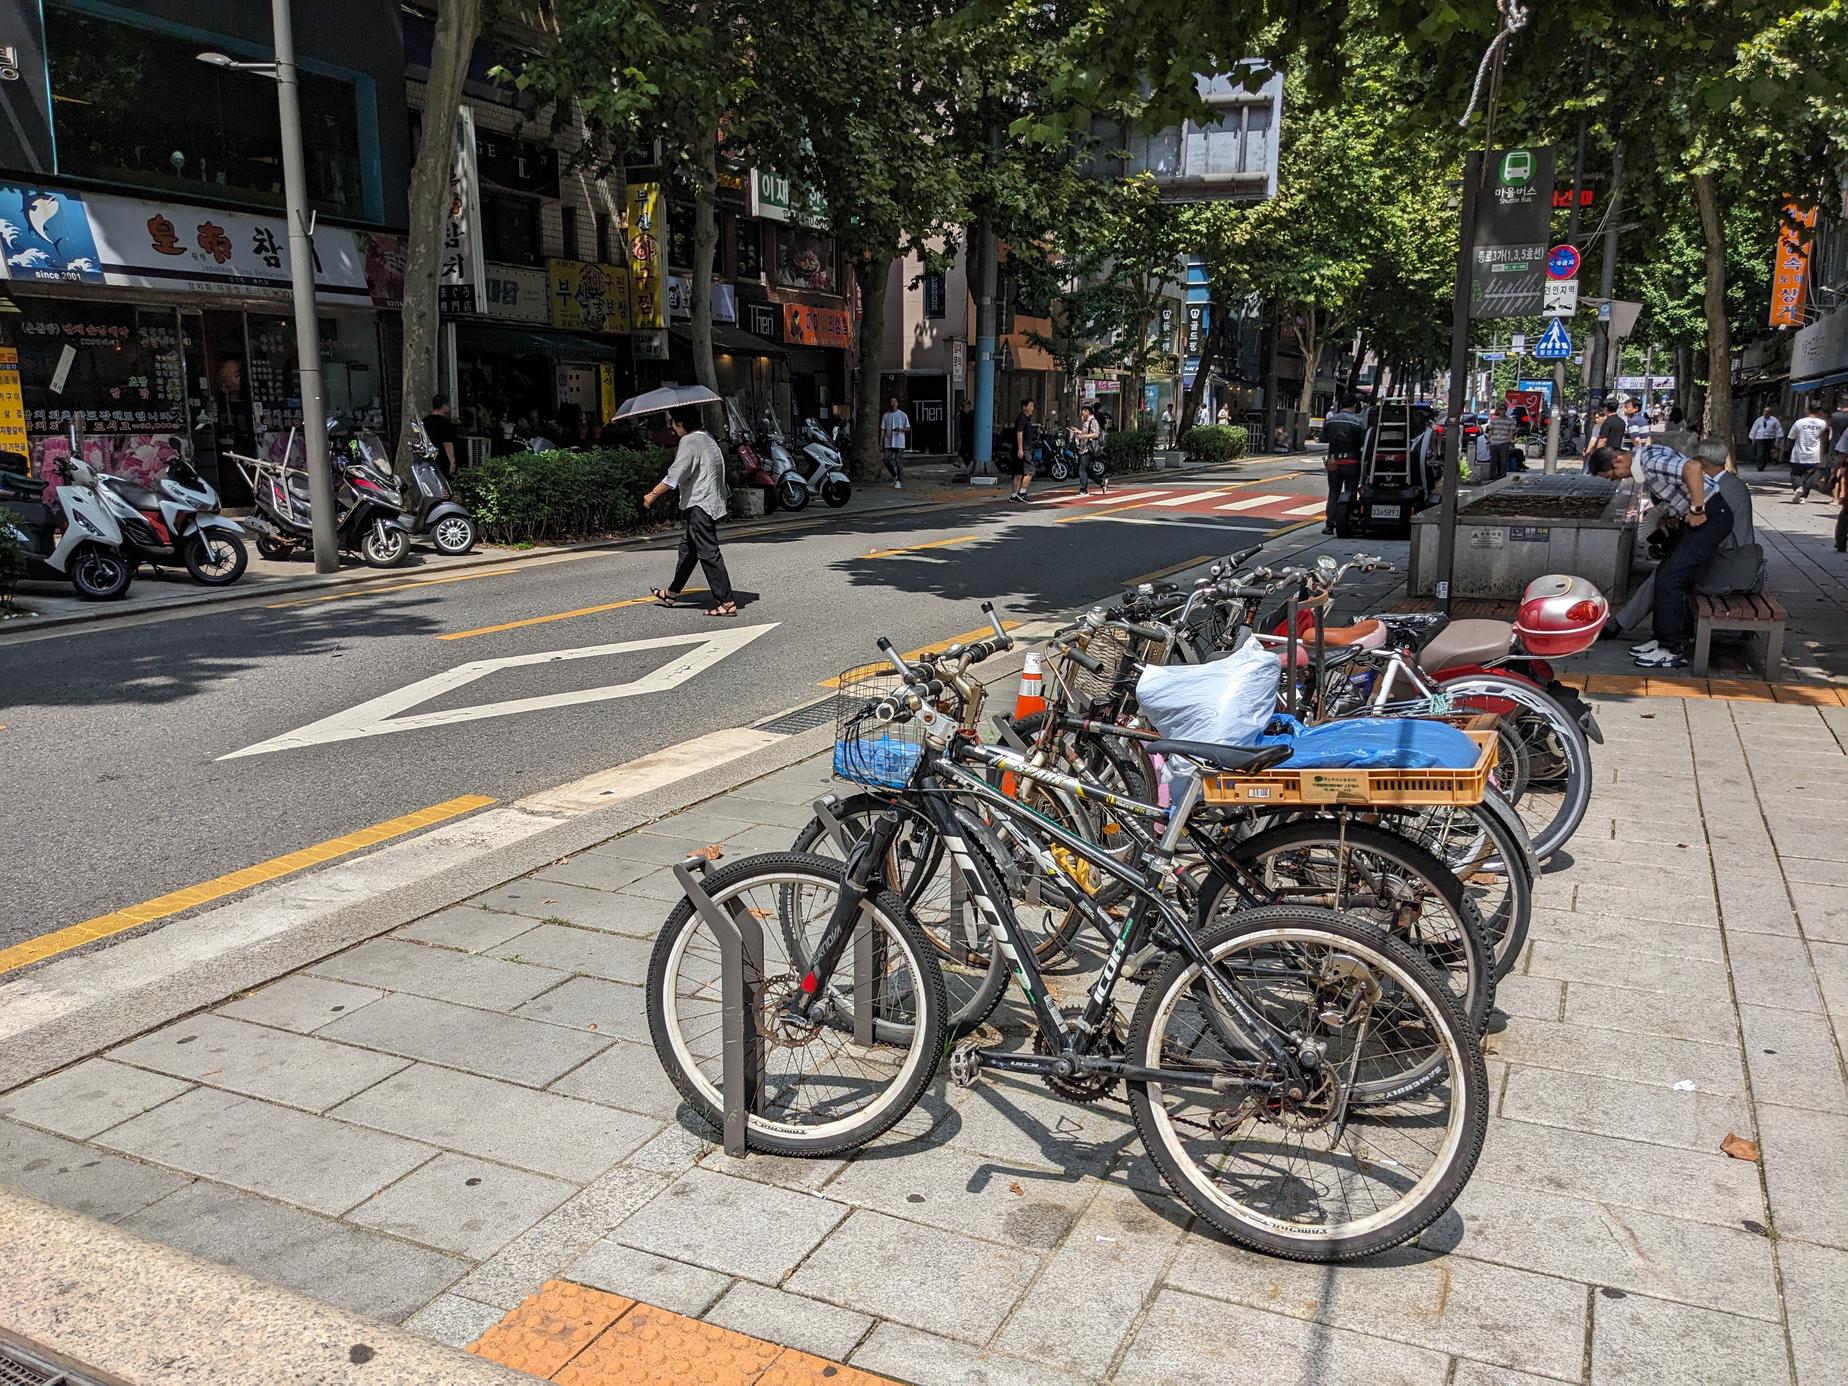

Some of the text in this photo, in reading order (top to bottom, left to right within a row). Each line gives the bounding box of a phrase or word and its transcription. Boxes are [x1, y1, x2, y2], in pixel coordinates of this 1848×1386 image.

[1494, 186, 1537, 199] 마을버스
[35, 270, 82, 281] since 2001
[748, 304, 775, 337] Then
[913, 400, 943, 422] Then
[1013, 761, 1072, 785] SPARK
[1213, 976, 1238, 1006] Aluminum
[1385, 1065, 1442, 1100] SAMCHULY
